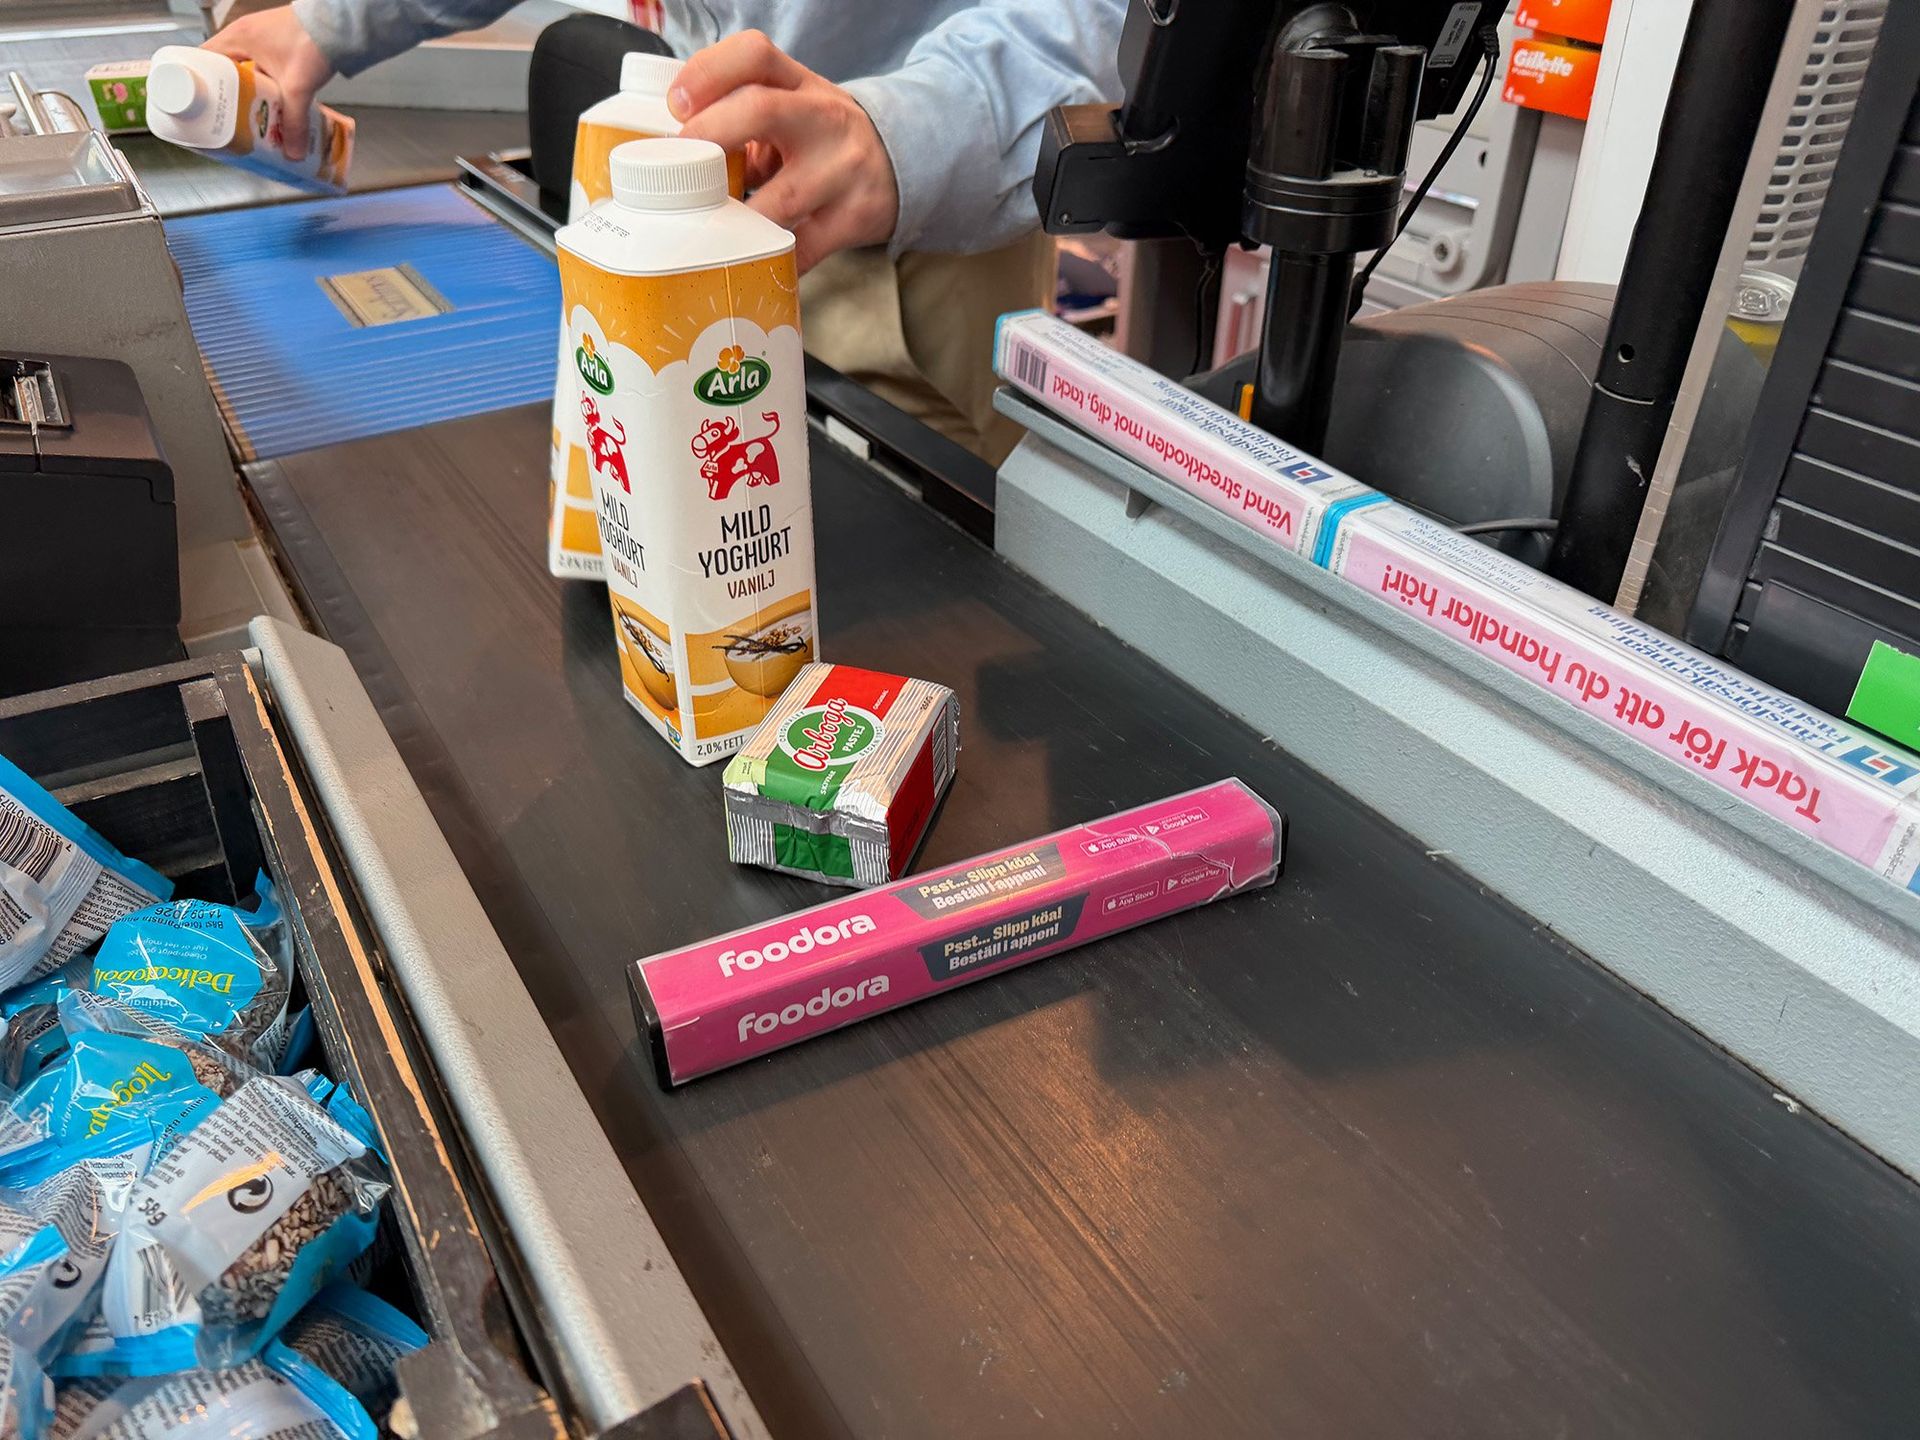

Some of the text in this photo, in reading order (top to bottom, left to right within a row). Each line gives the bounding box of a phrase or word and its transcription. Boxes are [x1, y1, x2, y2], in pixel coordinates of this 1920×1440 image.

[1514, 48, 1574, 77] Gillette
[579, 355, 608, 390] Arla
[706, 365, 760, 398] Arla
[1052, 374, 1085, 403] tack!
[1087, 392, 1112, 421] dig,
[1113, 410, 1144, 442] mot
[1145, 430, 1242, 501] streckkoden
[600, 487, 629, 532] MILD
[720, 503, 772, 544] MILD
[1243, 490, 1293, 537] Vänd
[596, 508, 645, 572] YOGHURT
[698, 525, 792, 579] YOGHURT
[610, 551, 638, 589] VANILJ
[727, 569, 776, 600] VANILJ
[1381, 564, 1823, 825] Tack för att du handlar här!
[1586, 605, 1853, 747] Fastighetsförmedling
[1610, 633, 1835, 752] Länsförsäkringar
[697, 734, 746, 756] 2,0% FETT
[792, 697, 855, 772] Arboga
[843, 724, 866, 752] PASTEJ
[25, 815, 63, 844] 315360
[1101, 838, 1118, 851] App
[1117, 833, 1139, 847] Store
[1162, 817, 1188, 831] Google
[1187, 812, 1204, 824] Play
[65, 843, 72, 853] 7
[918, 851, 1040, 898] Psst... Slipp köa!
[931, 883, 989, 911] Beställ
[993, 864, 1047, 894] appen!
[1117, 895, 1135, 908] App
[1134, 890, 1155, 903] Store
[717, 914, 878, 978] foodora
[943, 906, 1064, 958] Psst... Slipp köa!
[948, 942, 1003, 972] Beställ
[1009, 924, 1060, 950] appen!
[737, 974, 890, 1043] foodora
[281, 1107, 318, 1149] mjölkprotein.
[137, 1196, 166, 1227] 58g
